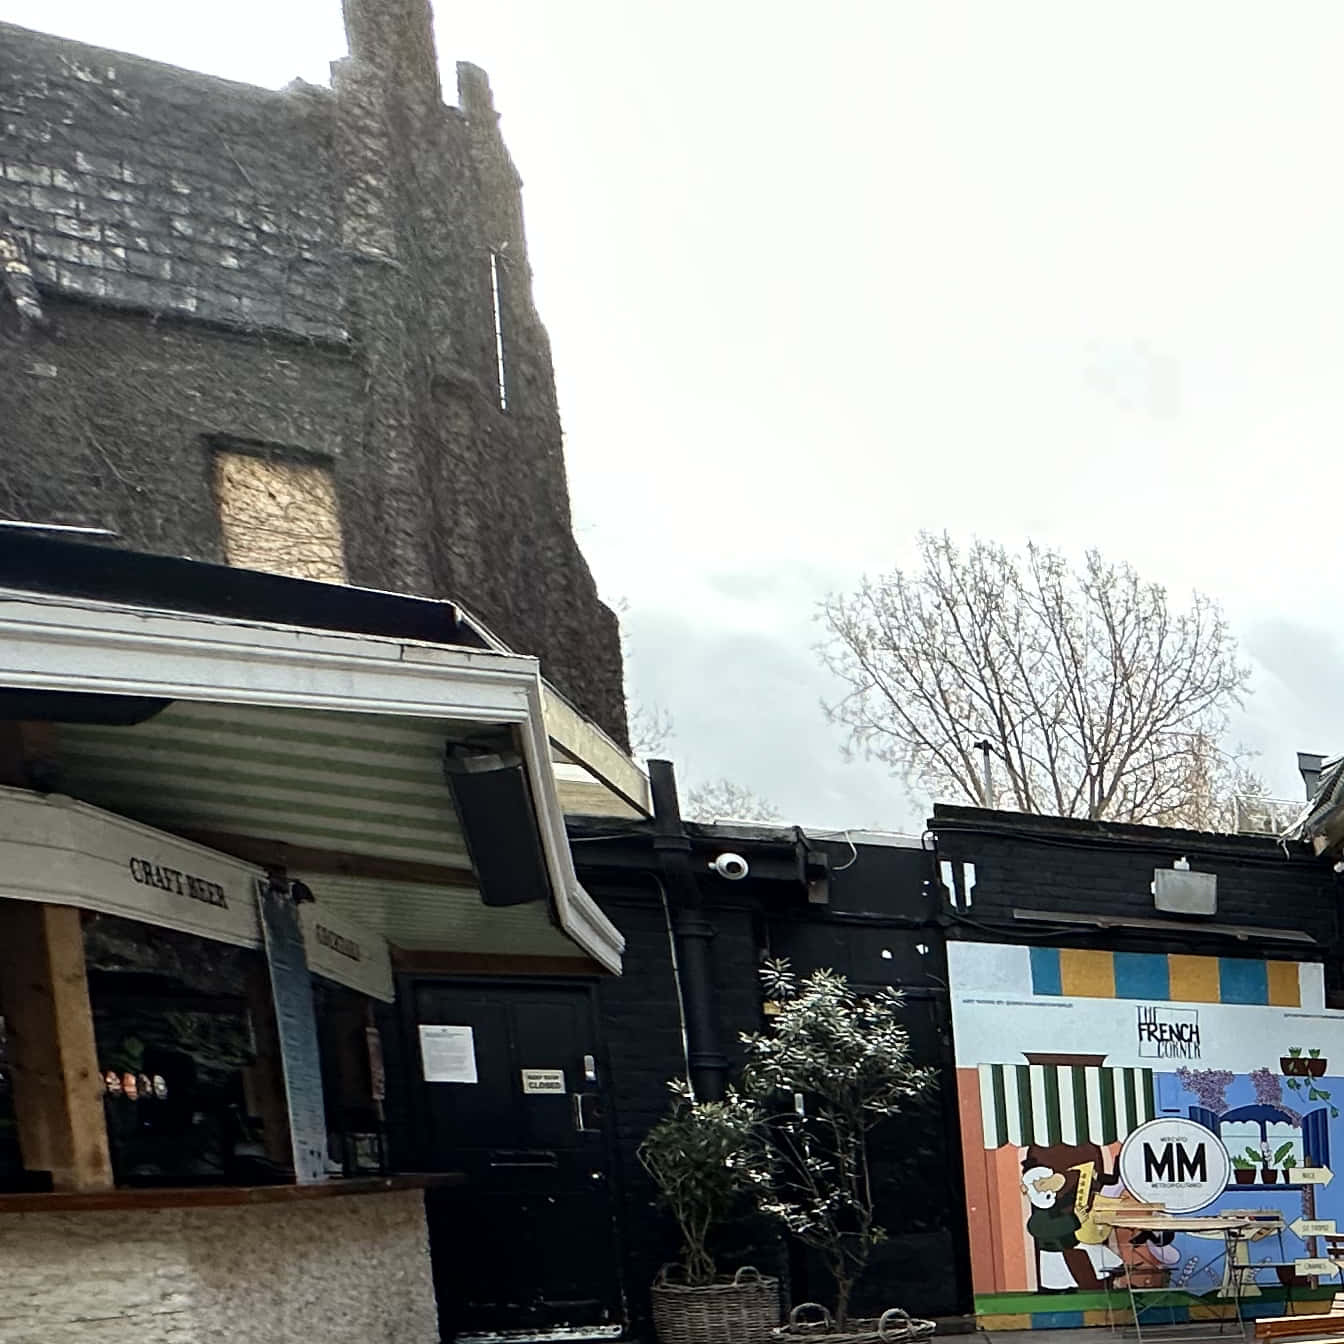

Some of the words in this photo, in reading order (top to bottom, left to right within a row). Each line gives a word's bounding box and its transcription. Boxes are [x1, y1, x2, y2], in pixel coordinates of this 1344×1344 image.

[129, 857, 184, 896] CRAFT
[185, 874, 229, 910] BEER
[1138, 1022, 1200, 1045] FRENCH
[528, 1081, 561, 1089] CLOSED
[1143, 1142, 1208, 1183] MM
